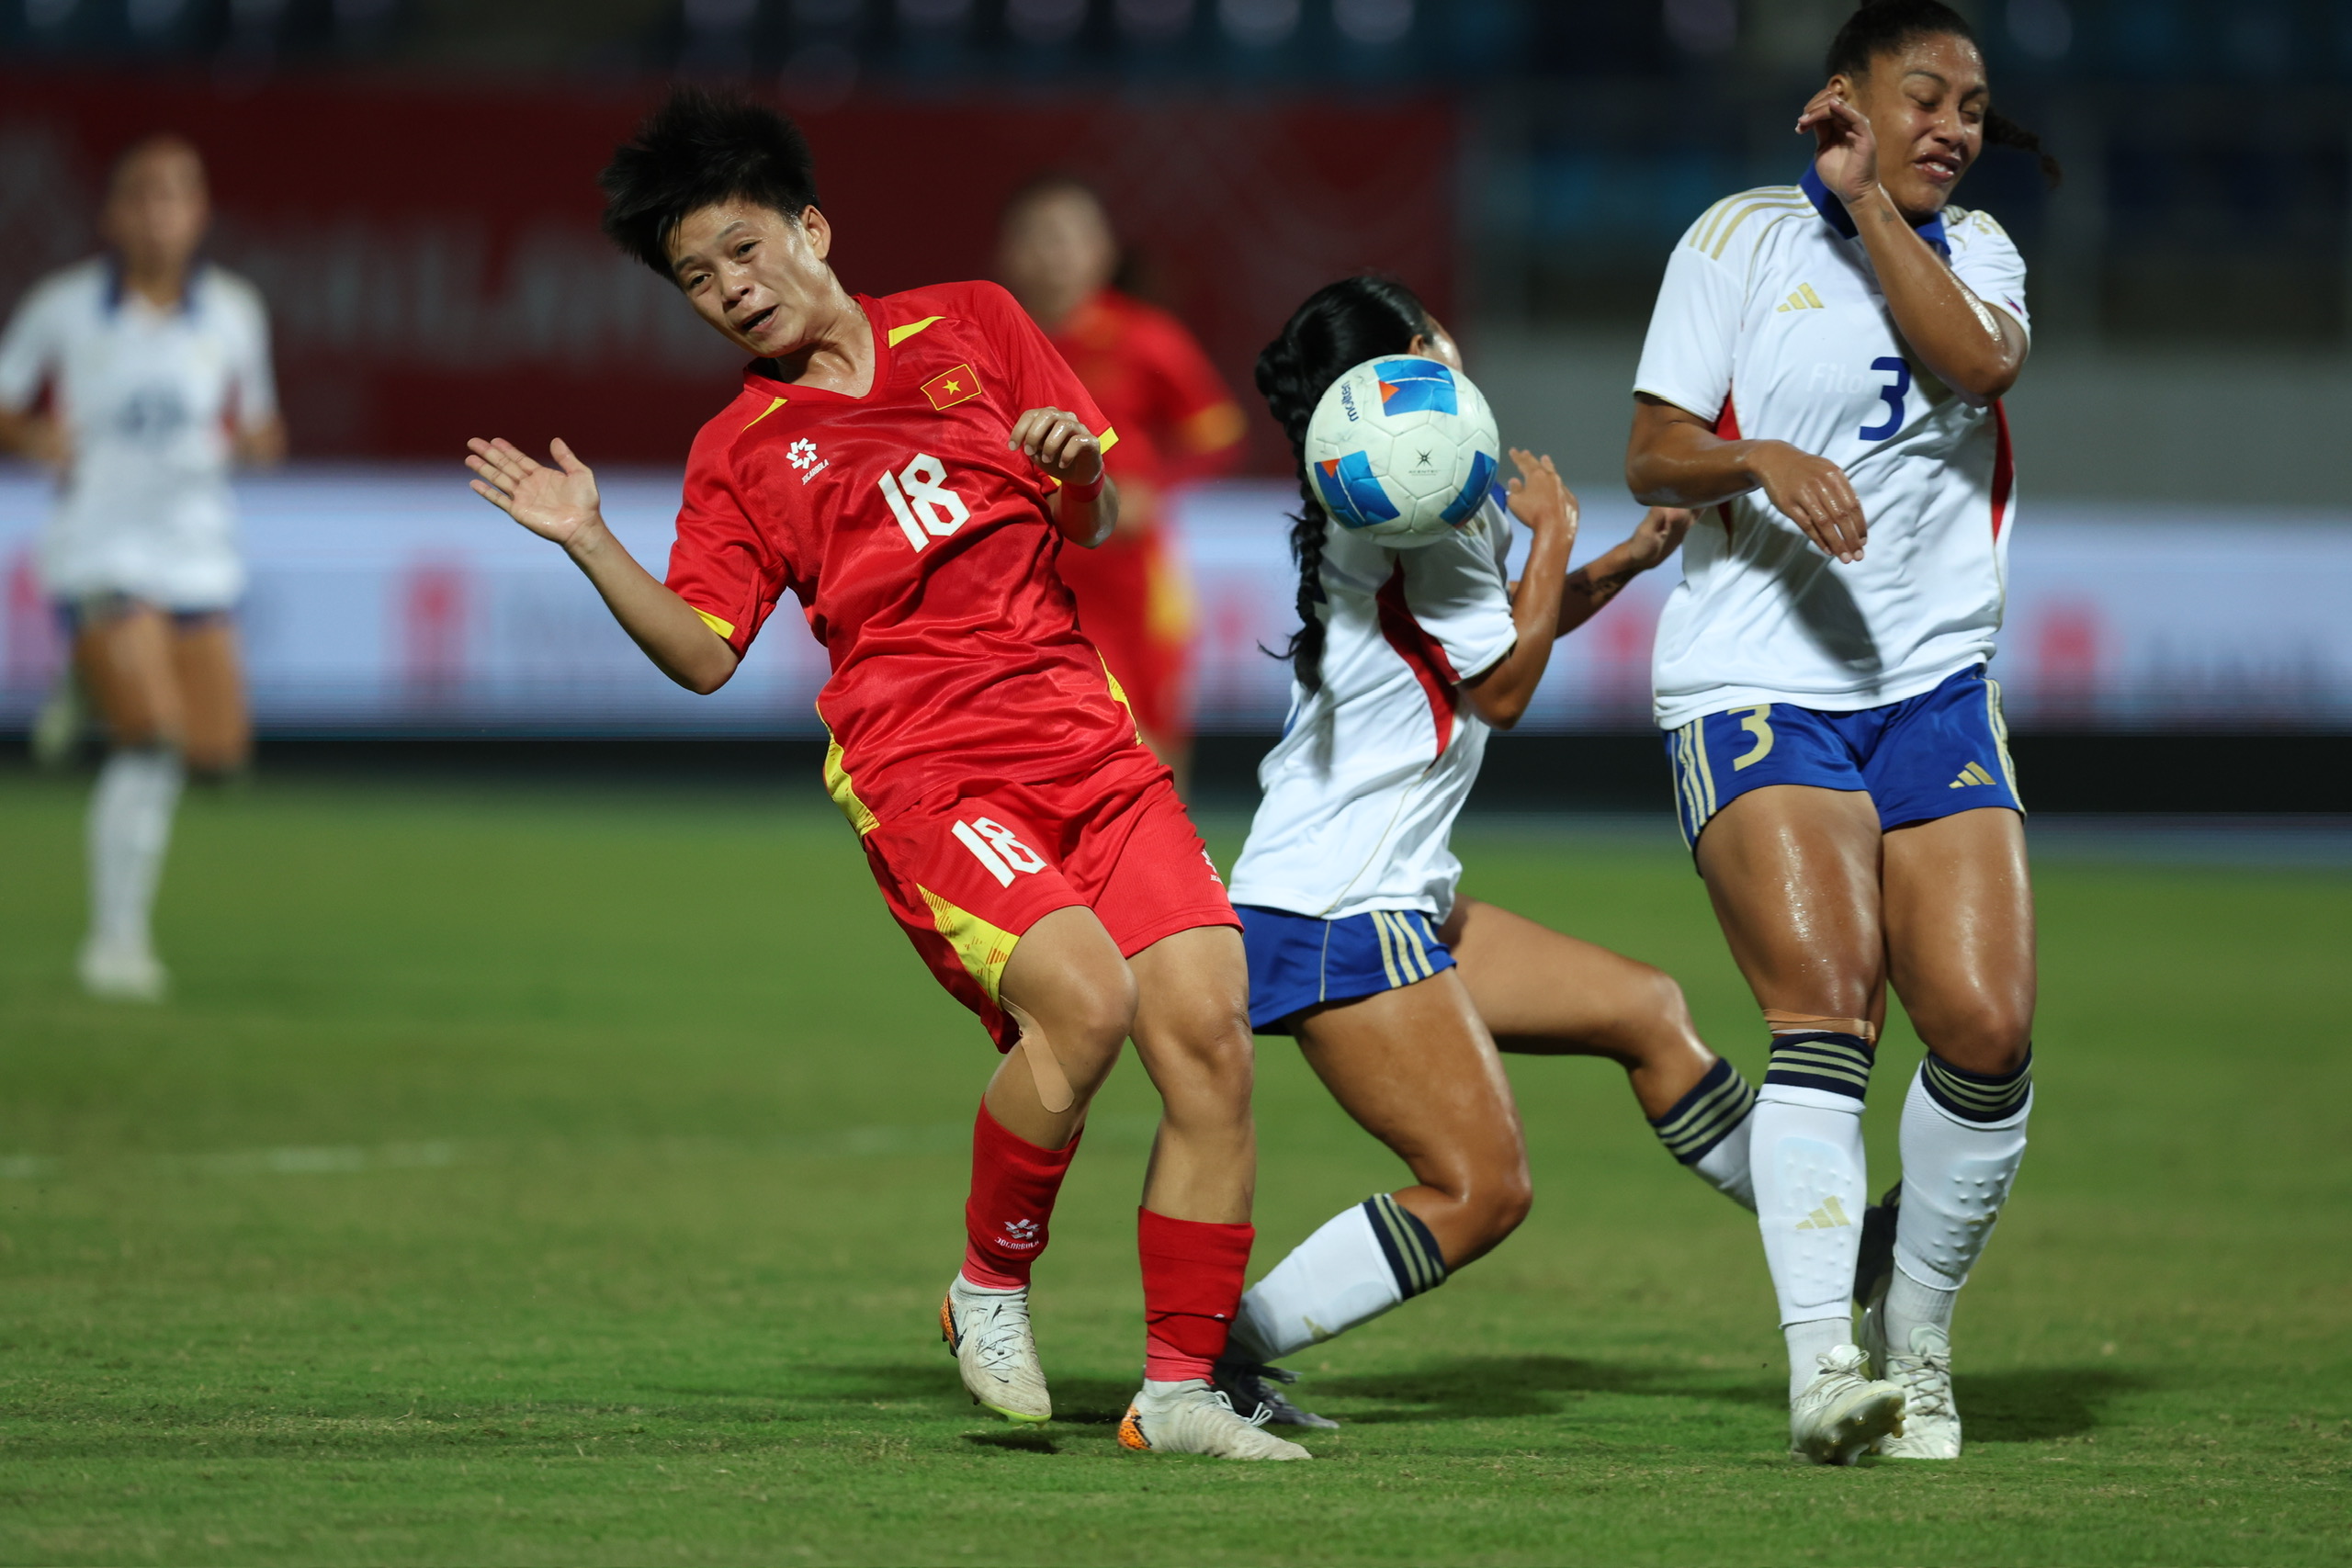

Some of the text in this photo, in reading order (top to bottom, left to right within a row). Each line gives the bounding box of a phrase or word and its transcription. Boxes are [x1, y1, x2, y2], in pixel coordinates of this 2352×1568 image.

[1341, 380, 1359, 422] molten
[1859, 356, 1911, 441] 3
[877, 452, 971, 553] 18
[1727, 704, 1775, 772] 3
[951, 817, 1048, 888] 18
